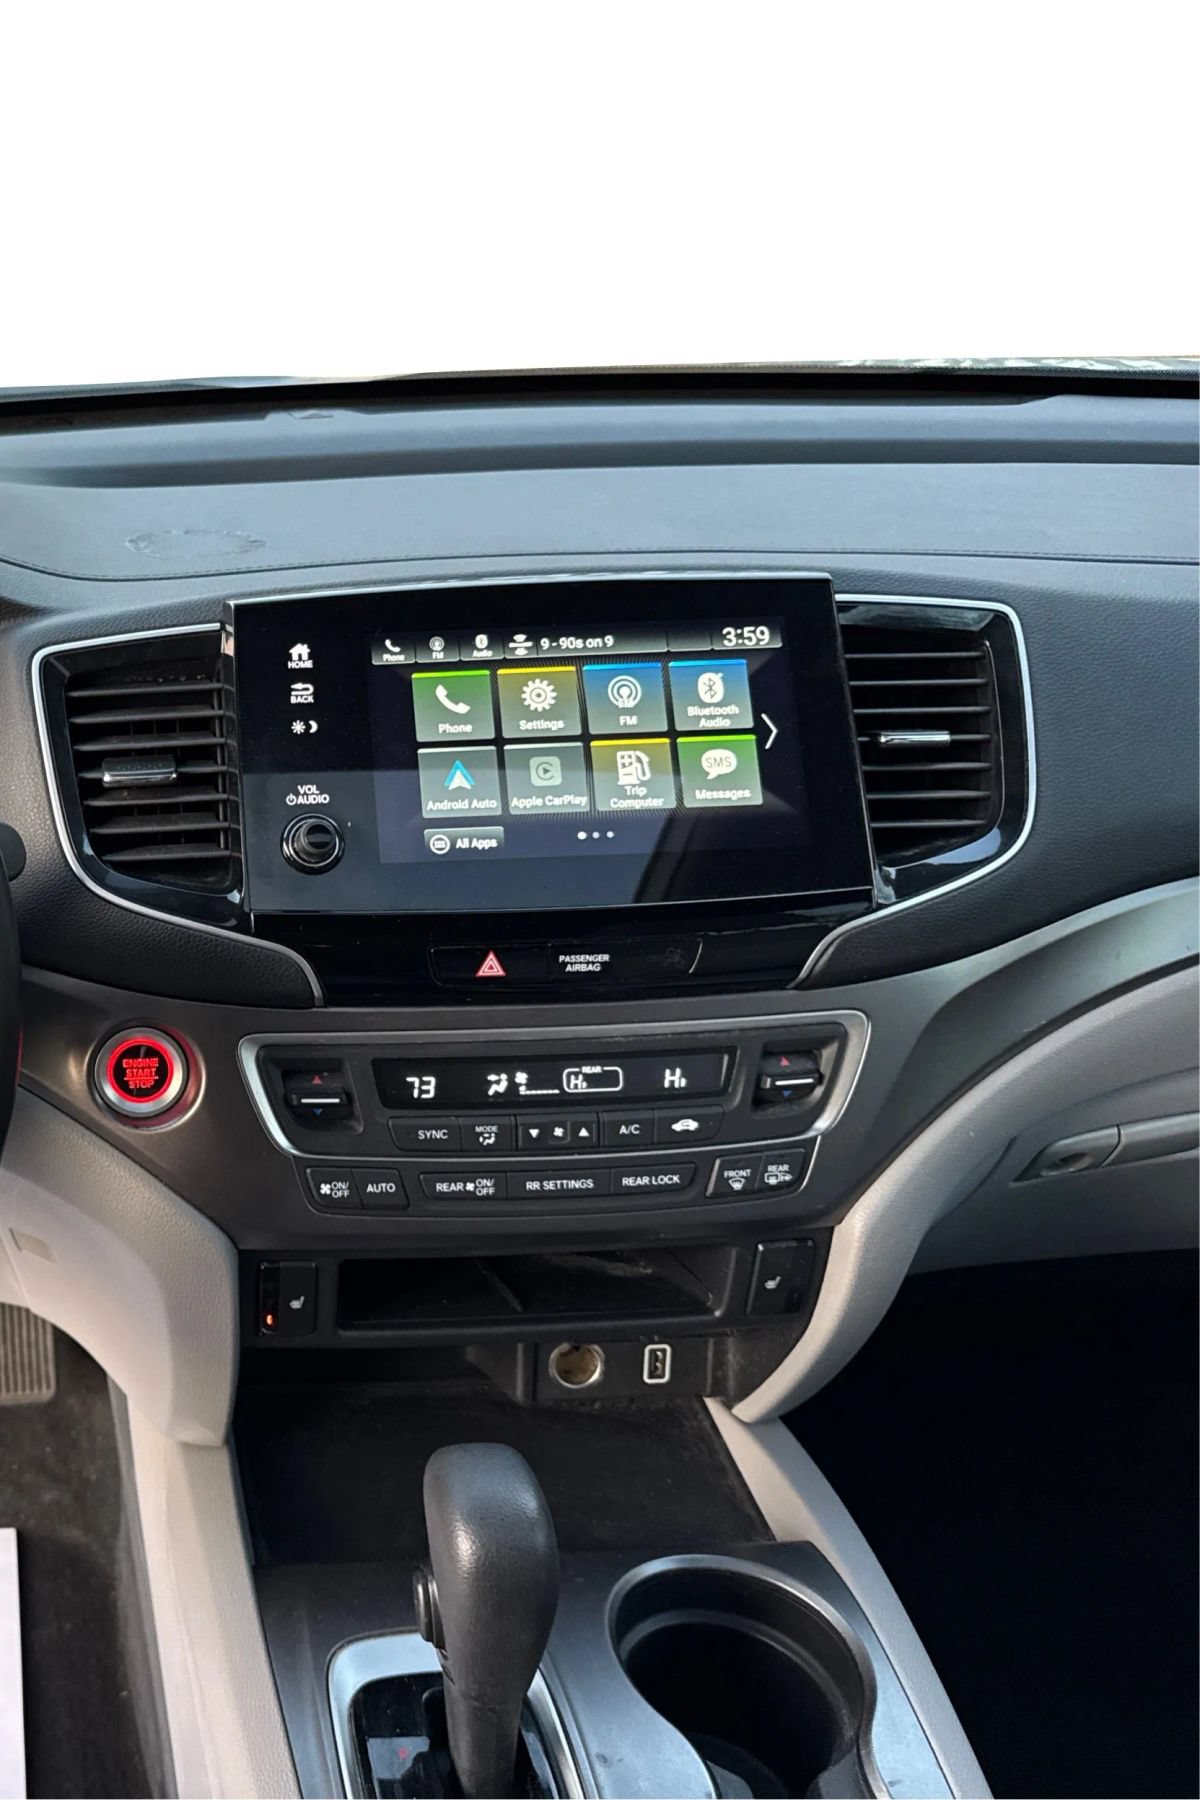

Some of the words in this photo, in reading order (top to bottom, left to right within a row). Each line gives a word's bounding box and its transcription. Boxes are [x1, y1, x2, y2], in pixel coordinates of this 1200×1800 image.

[722, 626, 770, 647] 3:59
[540, 639, 549, 650] 9
[560, 637, 584, 649] 90s
[586, 638, 603, 648] on
[604, 635, 614, 647] 9
[382, 654, 405, 662] Phone
[432, 652, 444, 660] FM
[472, 650, 493, 658] Audio
[288, 660, 313, 668] HOME
[290, 695, 314, 704] BACK
[687, 705, 740, 716] Bluetooth
[519, 719, 565, 731] Settings
[619, 716, 638, 726] FM
[700, 717, 731, 728] Audio
[438, 724, 472, 734] Phone
[705, 757, 732, 769] SMS
[298, 785, 320, 794] VOL
[624, 786, 647, 797] Trip
[297, 794, 330, 805] AUDIO
[695, 789, 752, 801] Messages
[427, 799, 469, 810] Android
[471, 799, 497, 809] Auto
[511, 797, 543, 809] Apple
[545, 795, 587, 808] CarPlay
[610, 798, 664, 810] Computer
[456, 838, 469, 849] All
[471, 838, 498, 850] Apps
[559, 954, 610, 964] PASSENGER
[565, 964, 601, 972] AIRBAG
[122, 1058, 159, 1068] ENGINE
[126, 1068, 156, 1078] START
[582, 1066, 602, 1074] REAR
[128, 1080, 155, 1088] STOP
[406, 1076, 436, 1099] 73
[475, 1126, 498, 1134] MODE
[619, 1123, 641, 1135] A/C
[418, 1129, 449, 1140] SYNC
[768, 1164, 789, 1172] REAR
[724, 1169, 751, 1178] FRONT
[526, 1181, 540, 1190] RR
[543, 1179, 594, 1190] SETTINGS
[622, 1177, 650, 1186] REAR
[652, 1174, 680, 1185] LOCK
[366, 1184, 396, 1192] AUTO
[436, 1182, 464, 1192] REAR
[476, 1188, 495, 1196] OFF
[332, 1190, 350, 1198] OFF
